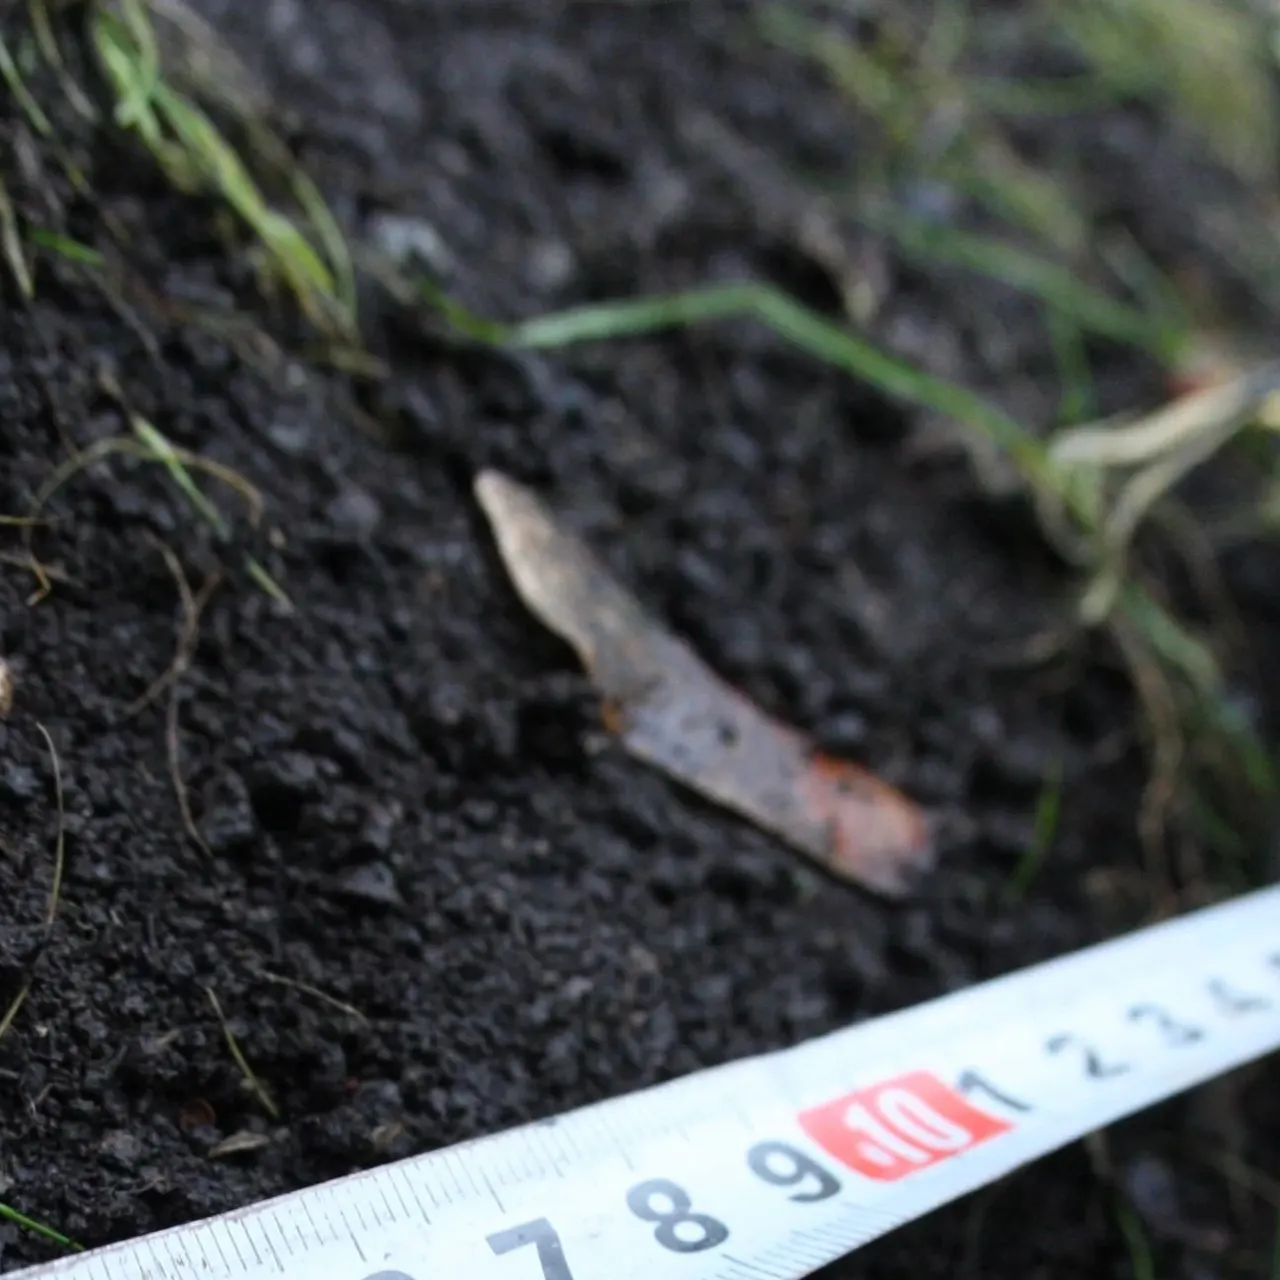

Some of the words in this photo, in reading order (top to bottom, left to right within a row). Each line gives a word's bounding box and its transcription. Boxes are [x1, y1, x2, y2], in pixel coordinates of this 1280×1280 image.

[625, 1178, 729, 1253] 8
[746, 1140, 841, 1202] 9
[844, 1087, 973, 1166] 10
[956, 1067, 1032, 1113] 1
[1045, 1033, 1130, 1079] 2
